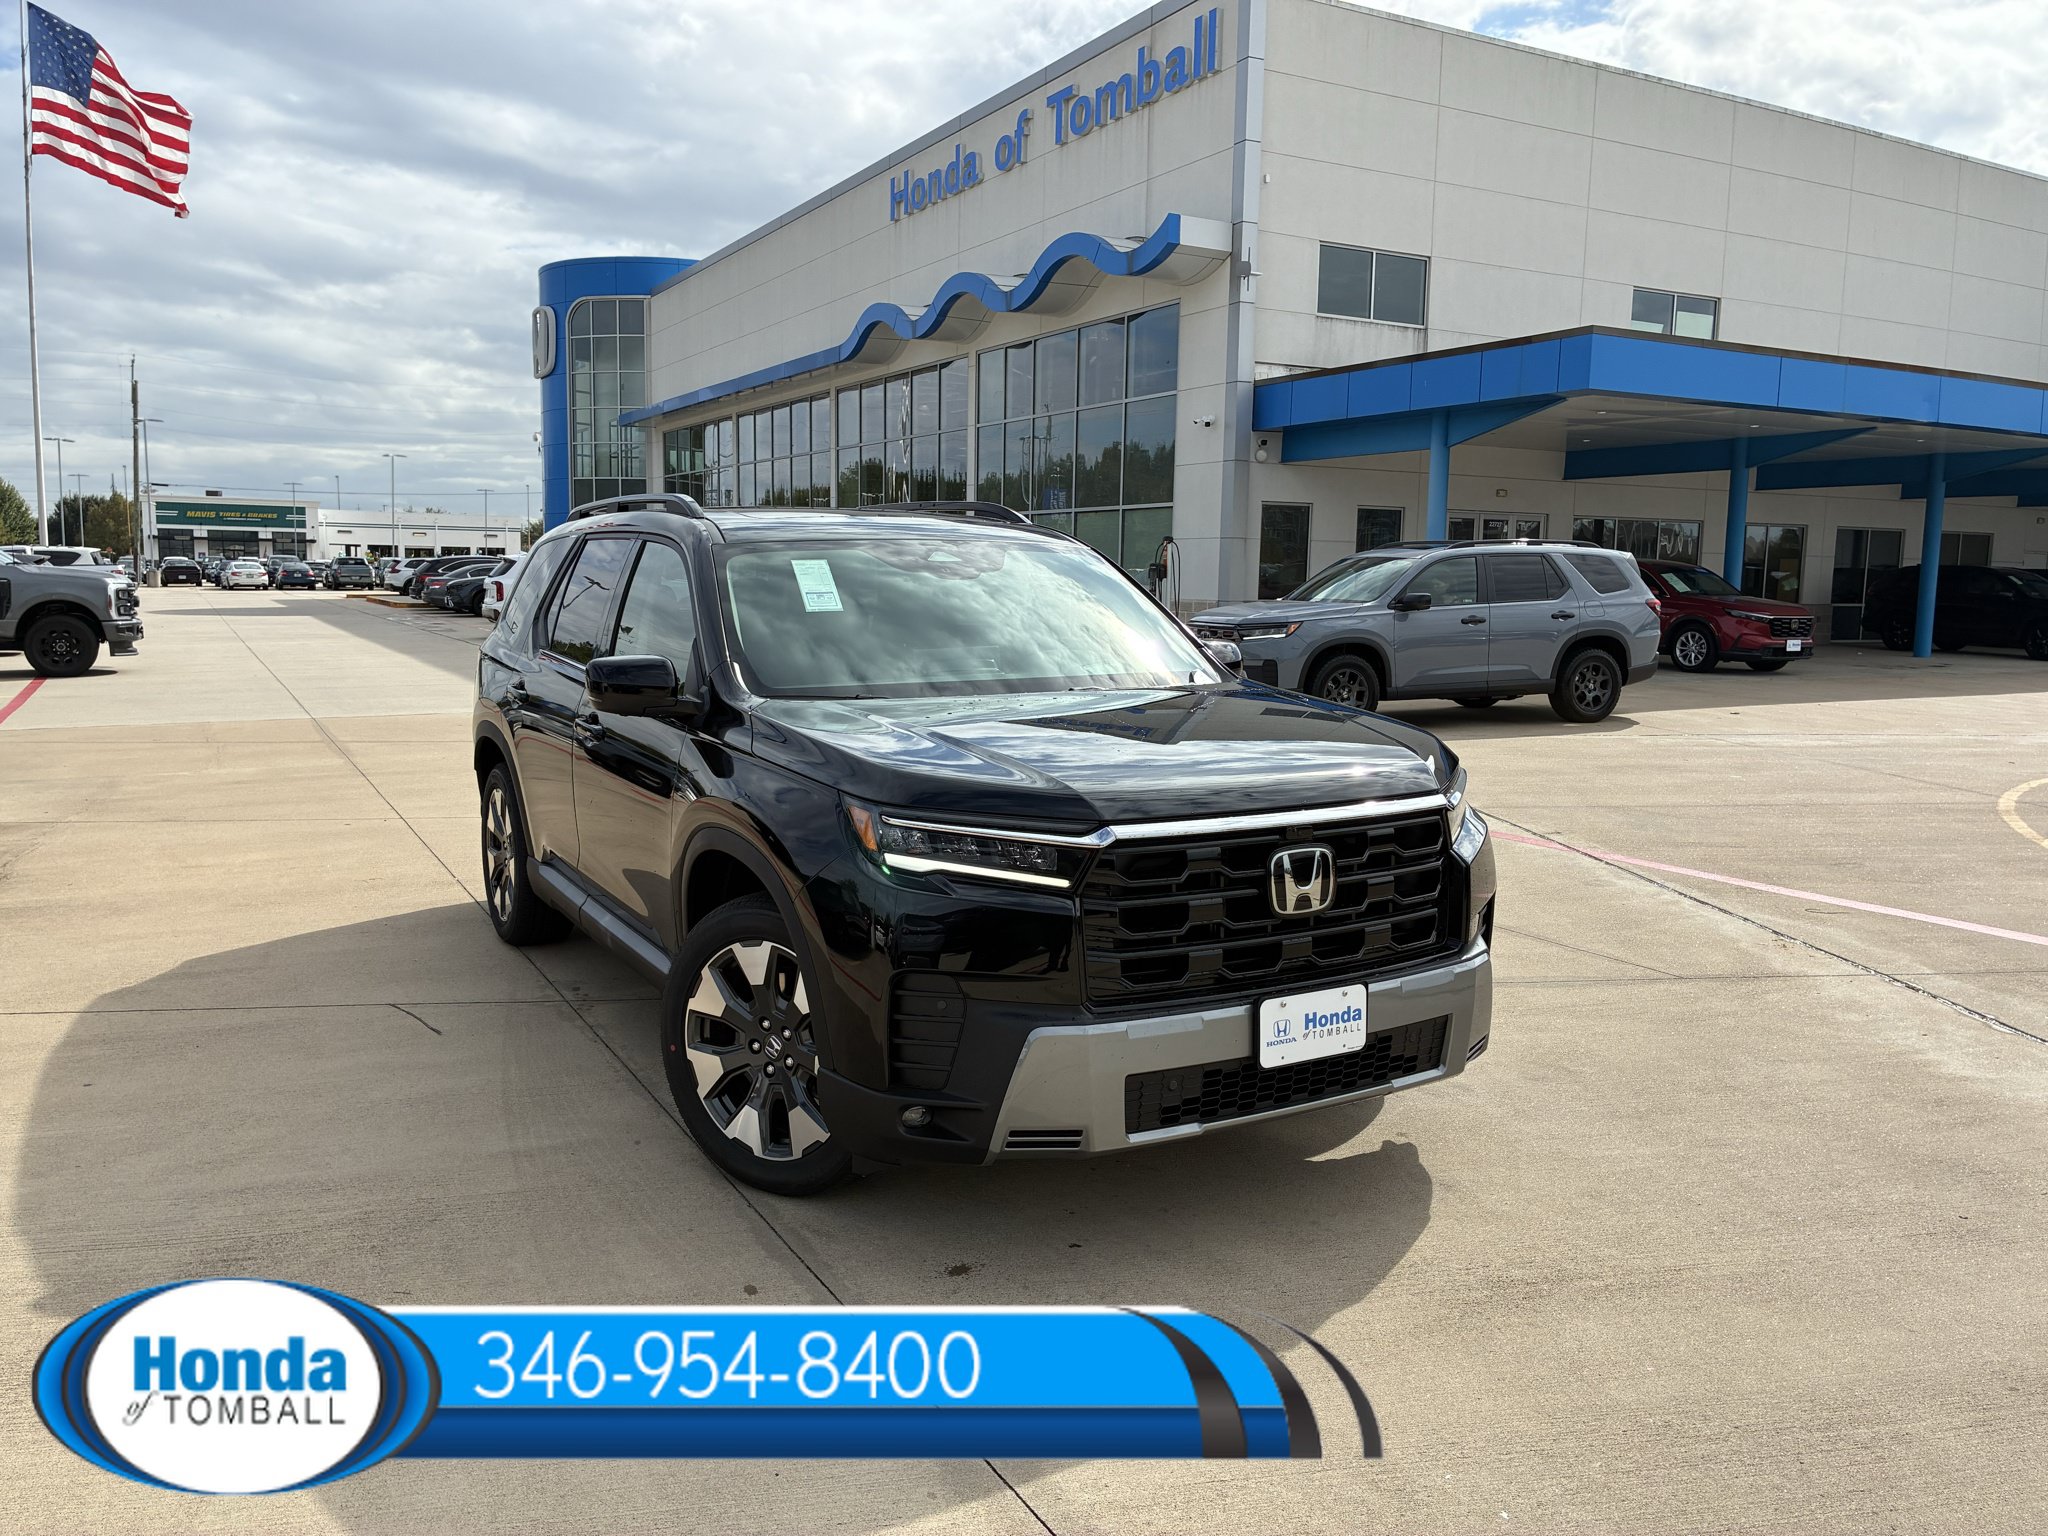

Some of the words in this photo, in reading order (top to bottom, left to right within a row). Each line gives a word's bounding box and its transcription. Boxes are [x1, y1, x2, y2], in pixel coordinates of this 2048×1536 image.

[889, 143, 983, 222] Honda
[994, 108, 1033, 172] of
[1046, 7, 1223, 146] Tomball
[186, 510, 216, 518] MAVIS
[1304, 1006, 1362, 1031] Honda
[1302, 1029, 1312, 1041] of
[1312, 1022, 1362, 1040] TOMBALL
[1266, 1036, 1297, 1047] HONDA
